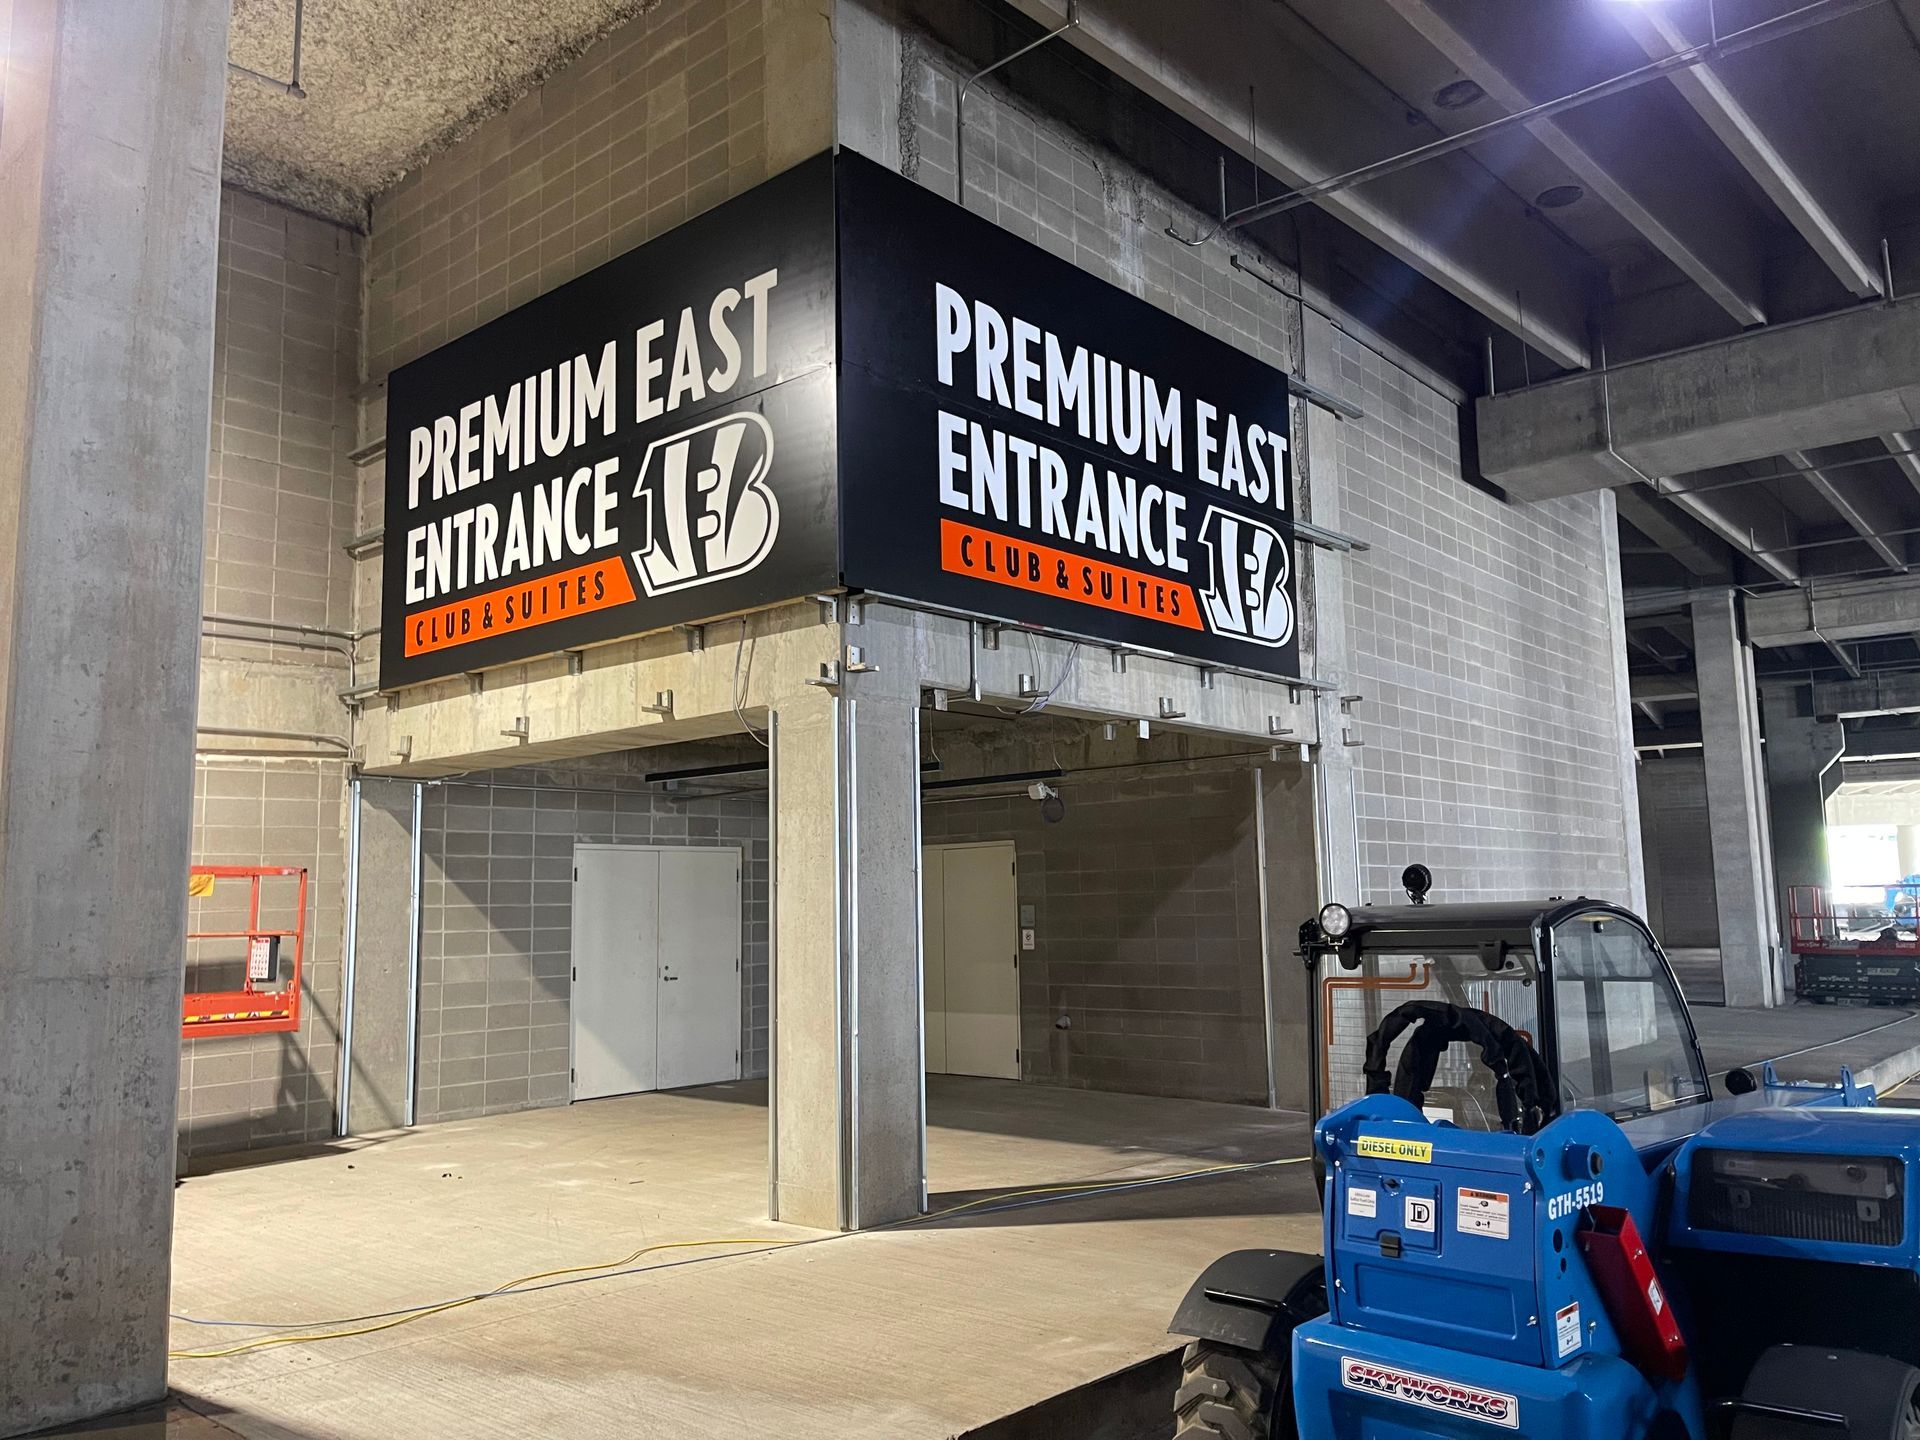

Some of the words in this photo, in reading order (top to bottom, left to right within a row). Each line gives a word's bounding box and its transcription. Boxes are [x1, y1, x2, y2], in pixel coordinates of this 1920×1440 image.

[407, 340, 617, 510] PREMIUM
[636, 267, 778, 424] EAST
[935, 281, 1183, 473] PREMIUM
[1196, 398, 1288, 511] EAST
[405, 456, 620, 605] ENTRANCE
[937, 409, 1188, 573] ENTRANCE
[415, 606, 472, 647] CLUB
[482, 603, 494, 630] &
[504, 570, 606, 625] SUITES
[960, 535, 1042, 583] CLUB
[1056, 559, 1071, 590] &
[1082, 566, 1181, 618] SUITES
[1361, 1140, 1397, 1154] DIESEL
[1398, 1144, 1427, 1157] ONLY
[1548, 1181, 1604, 1220] GTH-5519
[1347, 1363, 1508, 1420] SKYWORKS
